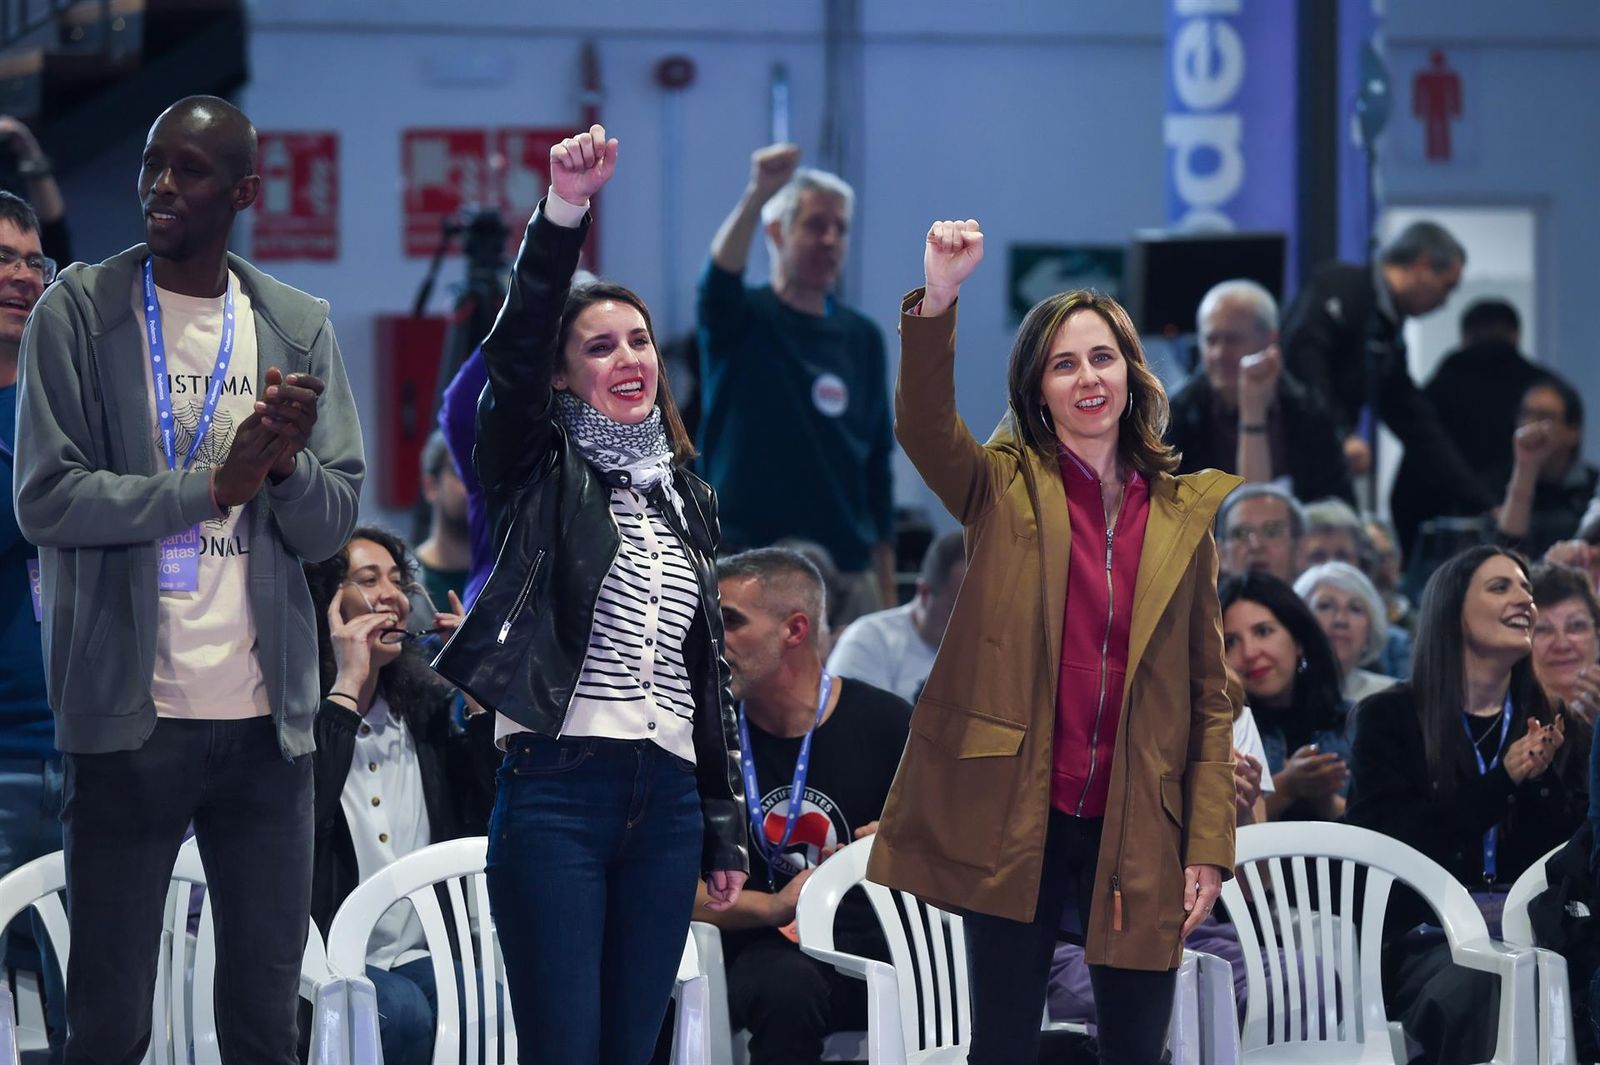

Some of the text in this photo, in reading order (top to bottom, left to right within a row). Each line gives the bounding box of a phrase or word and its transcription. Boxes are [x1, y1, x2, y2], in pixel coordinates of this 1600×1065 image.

[1163, 0, 1243, 232] de
[149, 319, 157, 345] Podemos
[156, 373, 164, 401] Podemos
